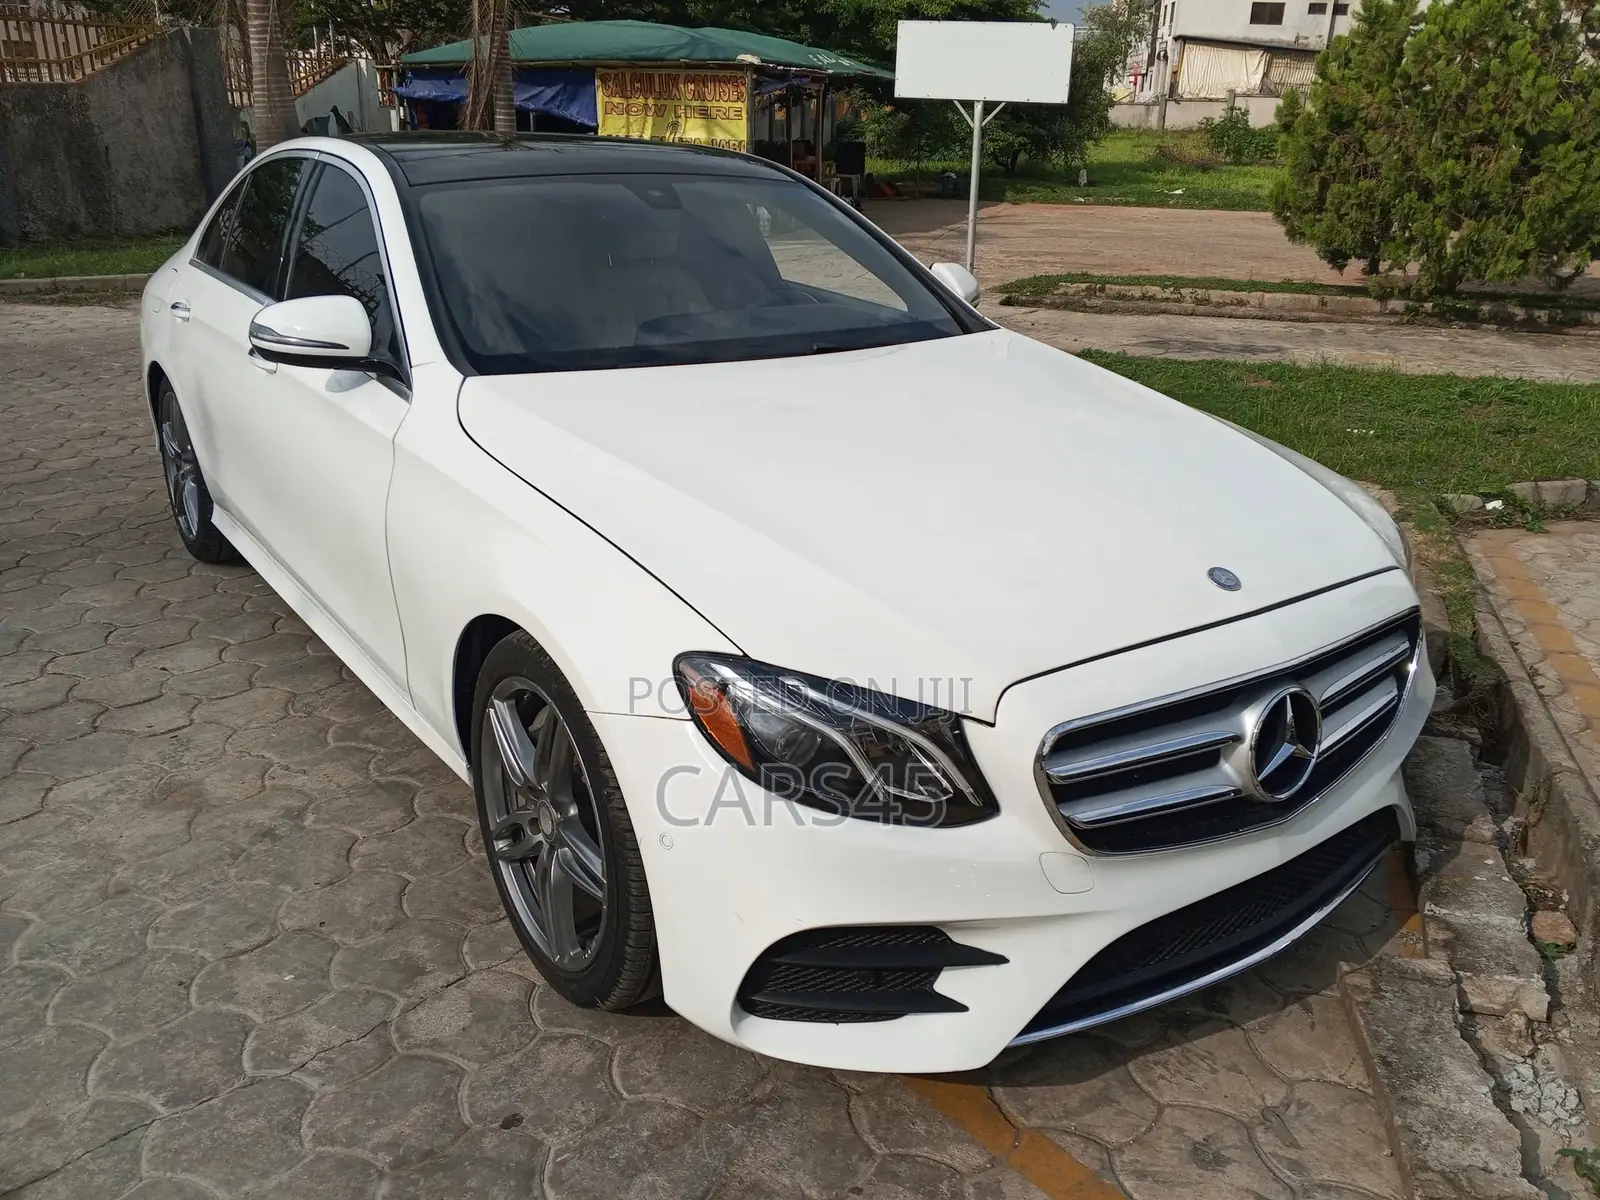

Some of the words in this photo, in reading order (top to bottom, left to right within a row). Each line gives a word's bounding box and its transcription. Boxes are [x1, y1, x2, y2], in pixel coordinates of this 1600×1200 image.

[601, 72, 682, 101] CALCULUX
[683, 73, 747, 103] CRUISES
[604, 101, 668, 118] NOW
[674, 104, 743, 120] HERE
[666, 120, 683, 135] @
